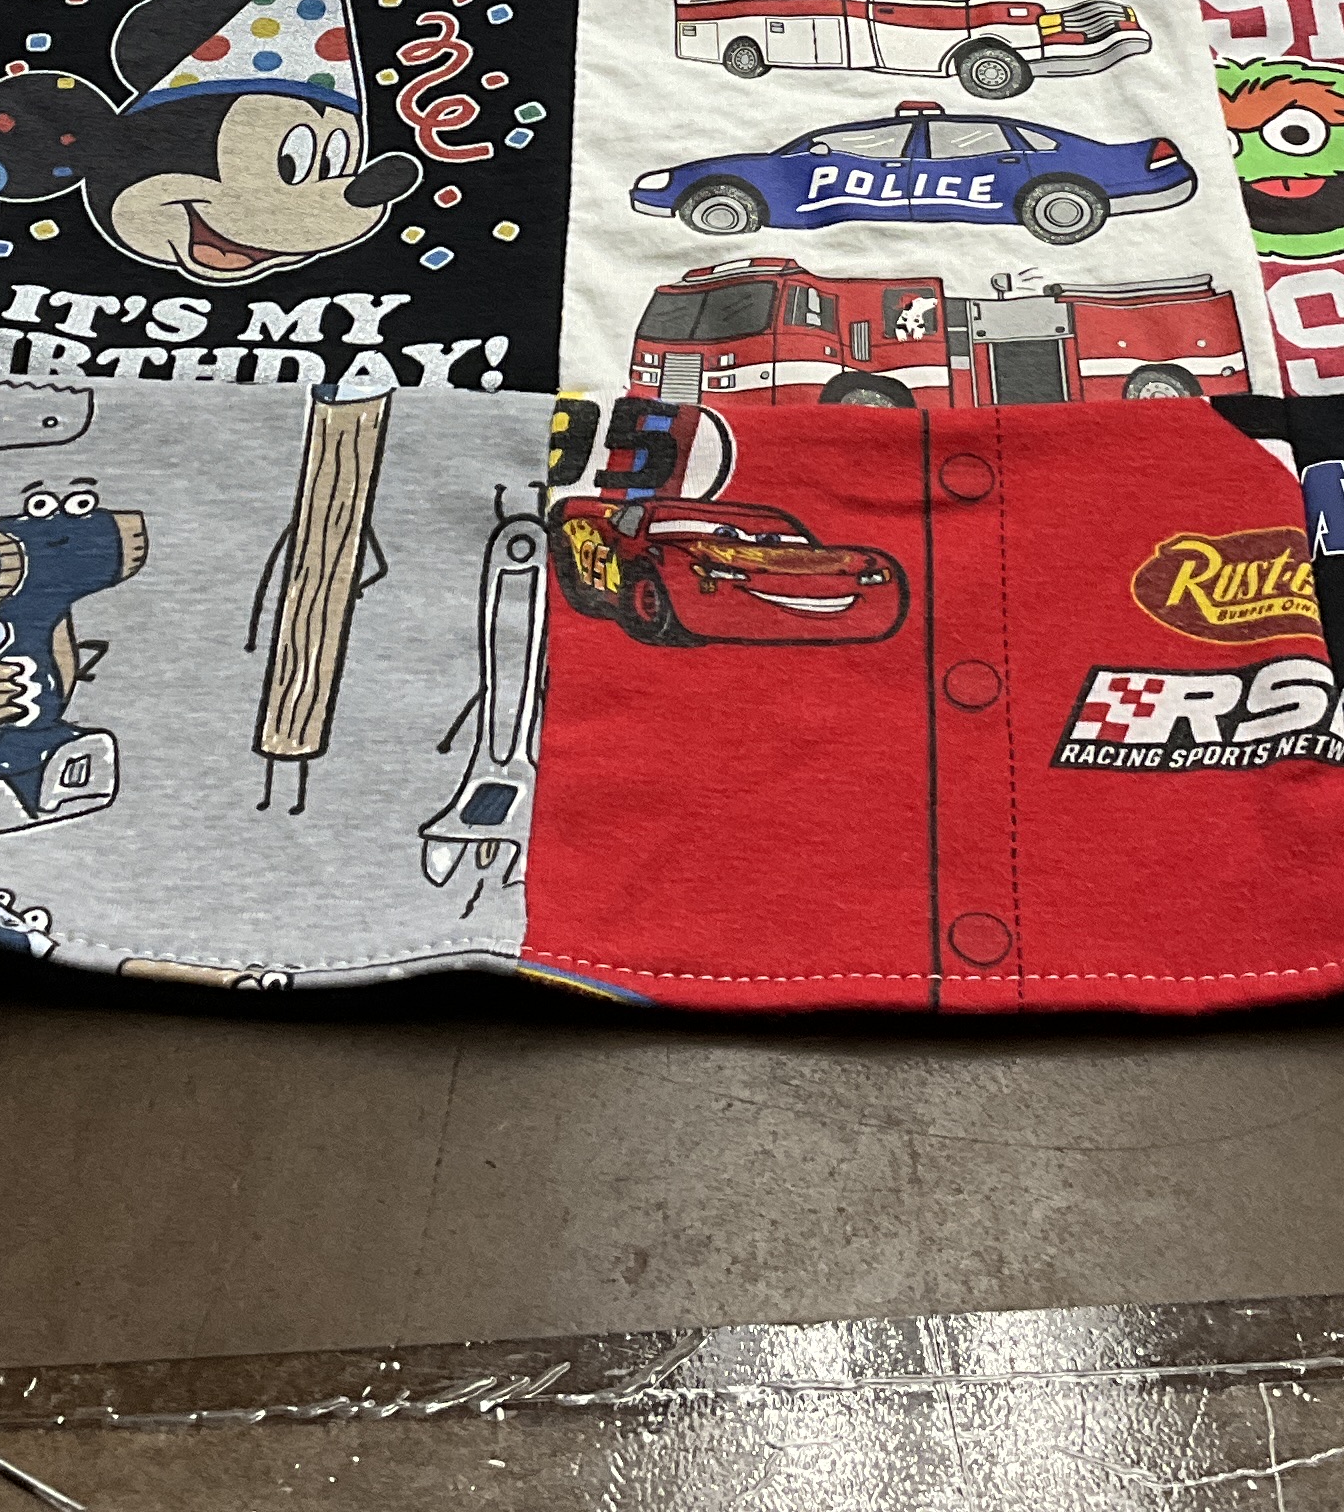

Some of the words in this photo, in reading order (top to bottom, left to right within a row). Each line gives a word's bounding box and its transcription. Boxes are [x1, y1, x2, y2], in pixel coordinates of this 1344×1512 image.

[807, 164, 997, 204] POLICE
[1, 284, 212, 344] IT'S
[237, 293, 412, 346] MY
[1060, 743, 1163, 768] RACING
[1168, 741, 1273, 769] SPORTS
